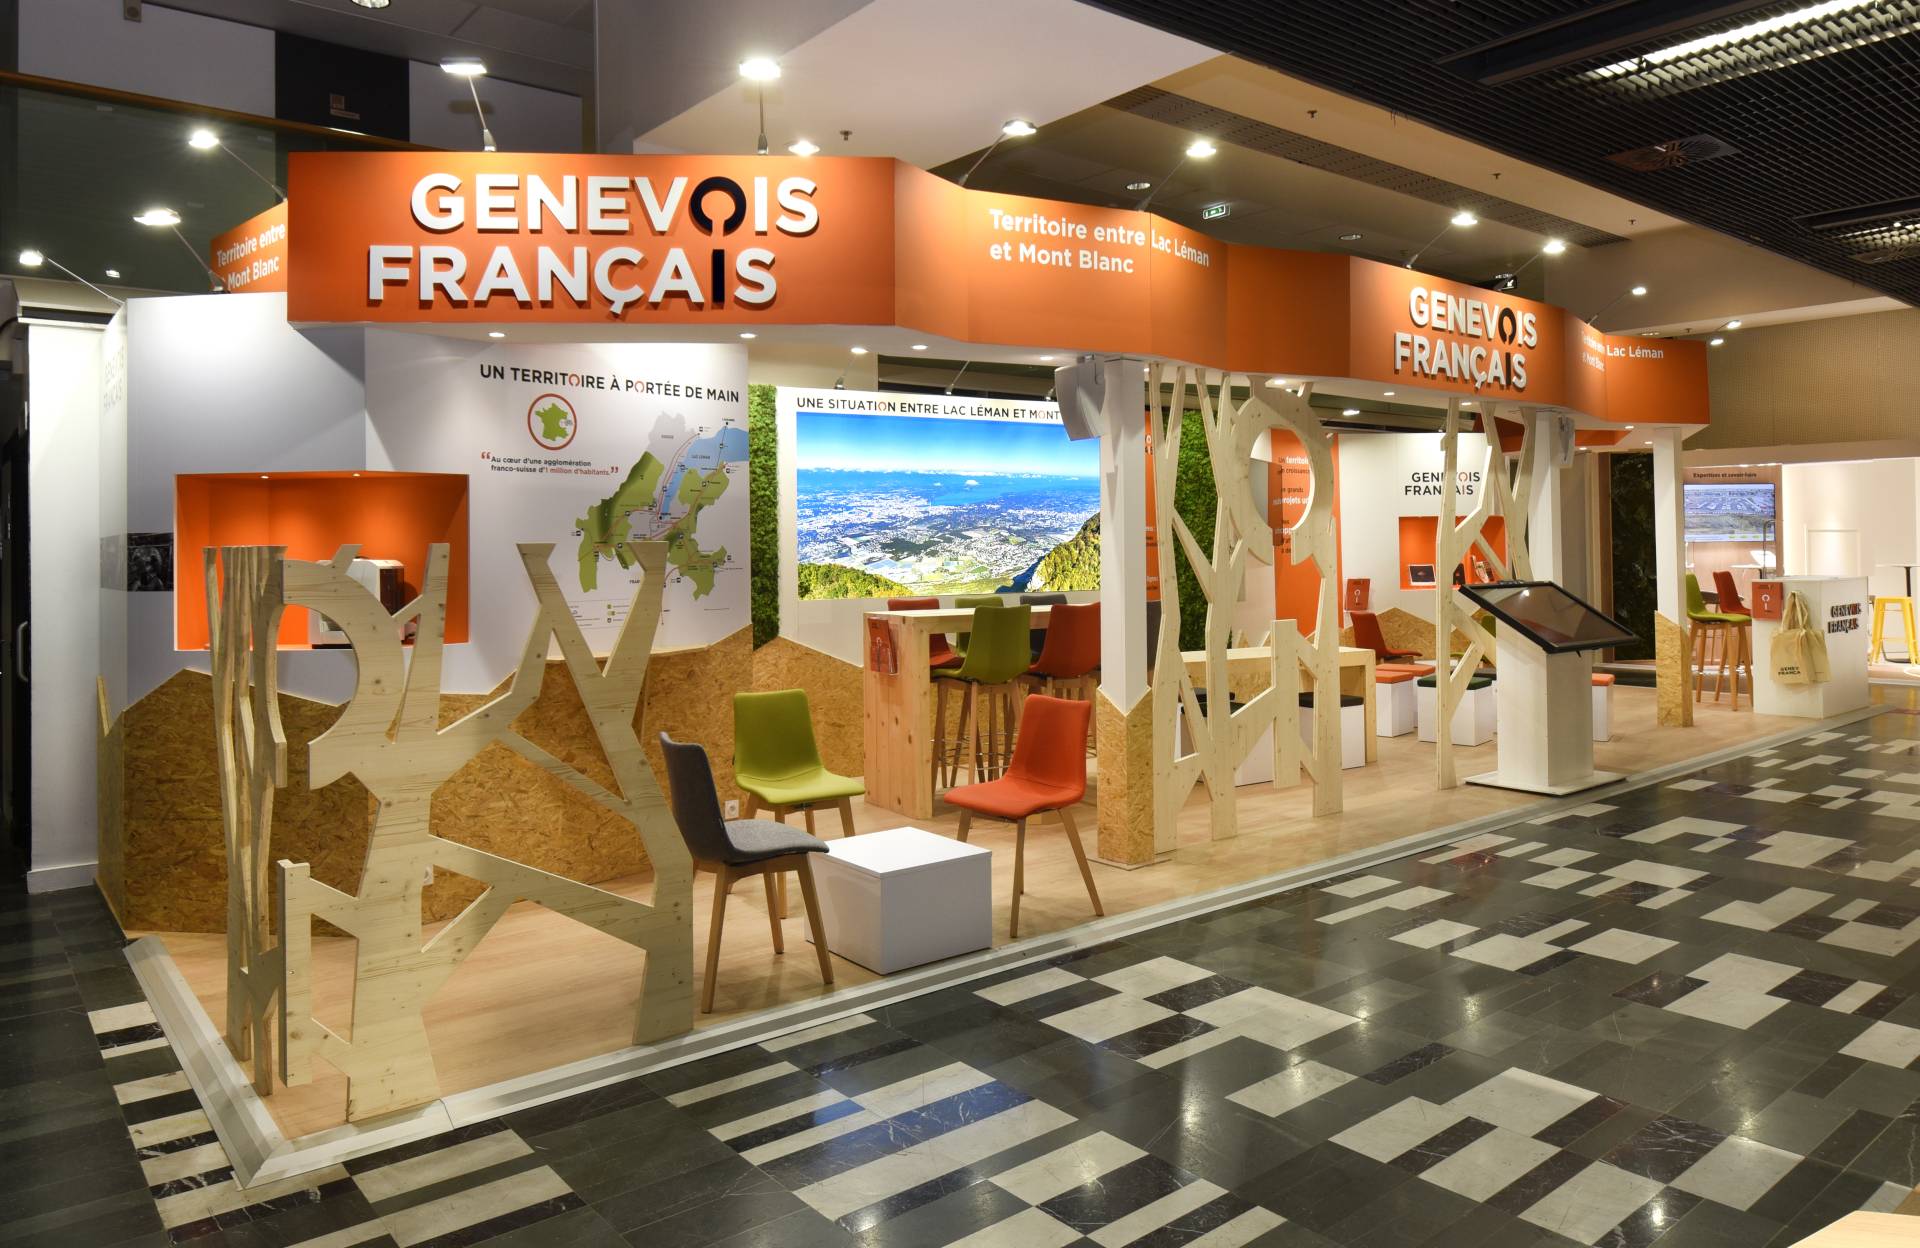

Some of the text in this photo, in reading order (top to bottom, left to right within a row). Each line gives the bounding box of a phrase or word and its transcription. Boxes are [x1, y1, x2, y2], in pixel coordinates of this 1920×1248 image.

[410, 173, 820, 237] GENEVOIS
[217, 223, 286, 268] Territoire entre
[989, 208, 1210, 267] Territoire entre Lac Léman
[227, 256, 280, 291] Mont Blanc
[989, 242, 1134, 274] et Mont Blanc
[368, 245, 778, 317] FRANÇAIS
[1409, 286, 1538, 348] GENEVOIS
[1394, 330, 1528, 391] FRANÇAIS
[1606, 344, 1626, 358] Lac
[1628, 345, 1664, 359] Léman
[480, 364, 739, 403] UN TERRITOIRE À PORTÉE DE MAIN
[797, 397, 1060, 420] UNE SITUATION ENTRE LAC LÉMAN ET MONT
[490, 464, 536, 473] franco-suisse
[550, 467, 575, 475] million
[543, 459, 592, 468] agglomération
[1411, 471, 1481, 483] GENOIS
[1404, 484, 1474, 496] FRANAIS
